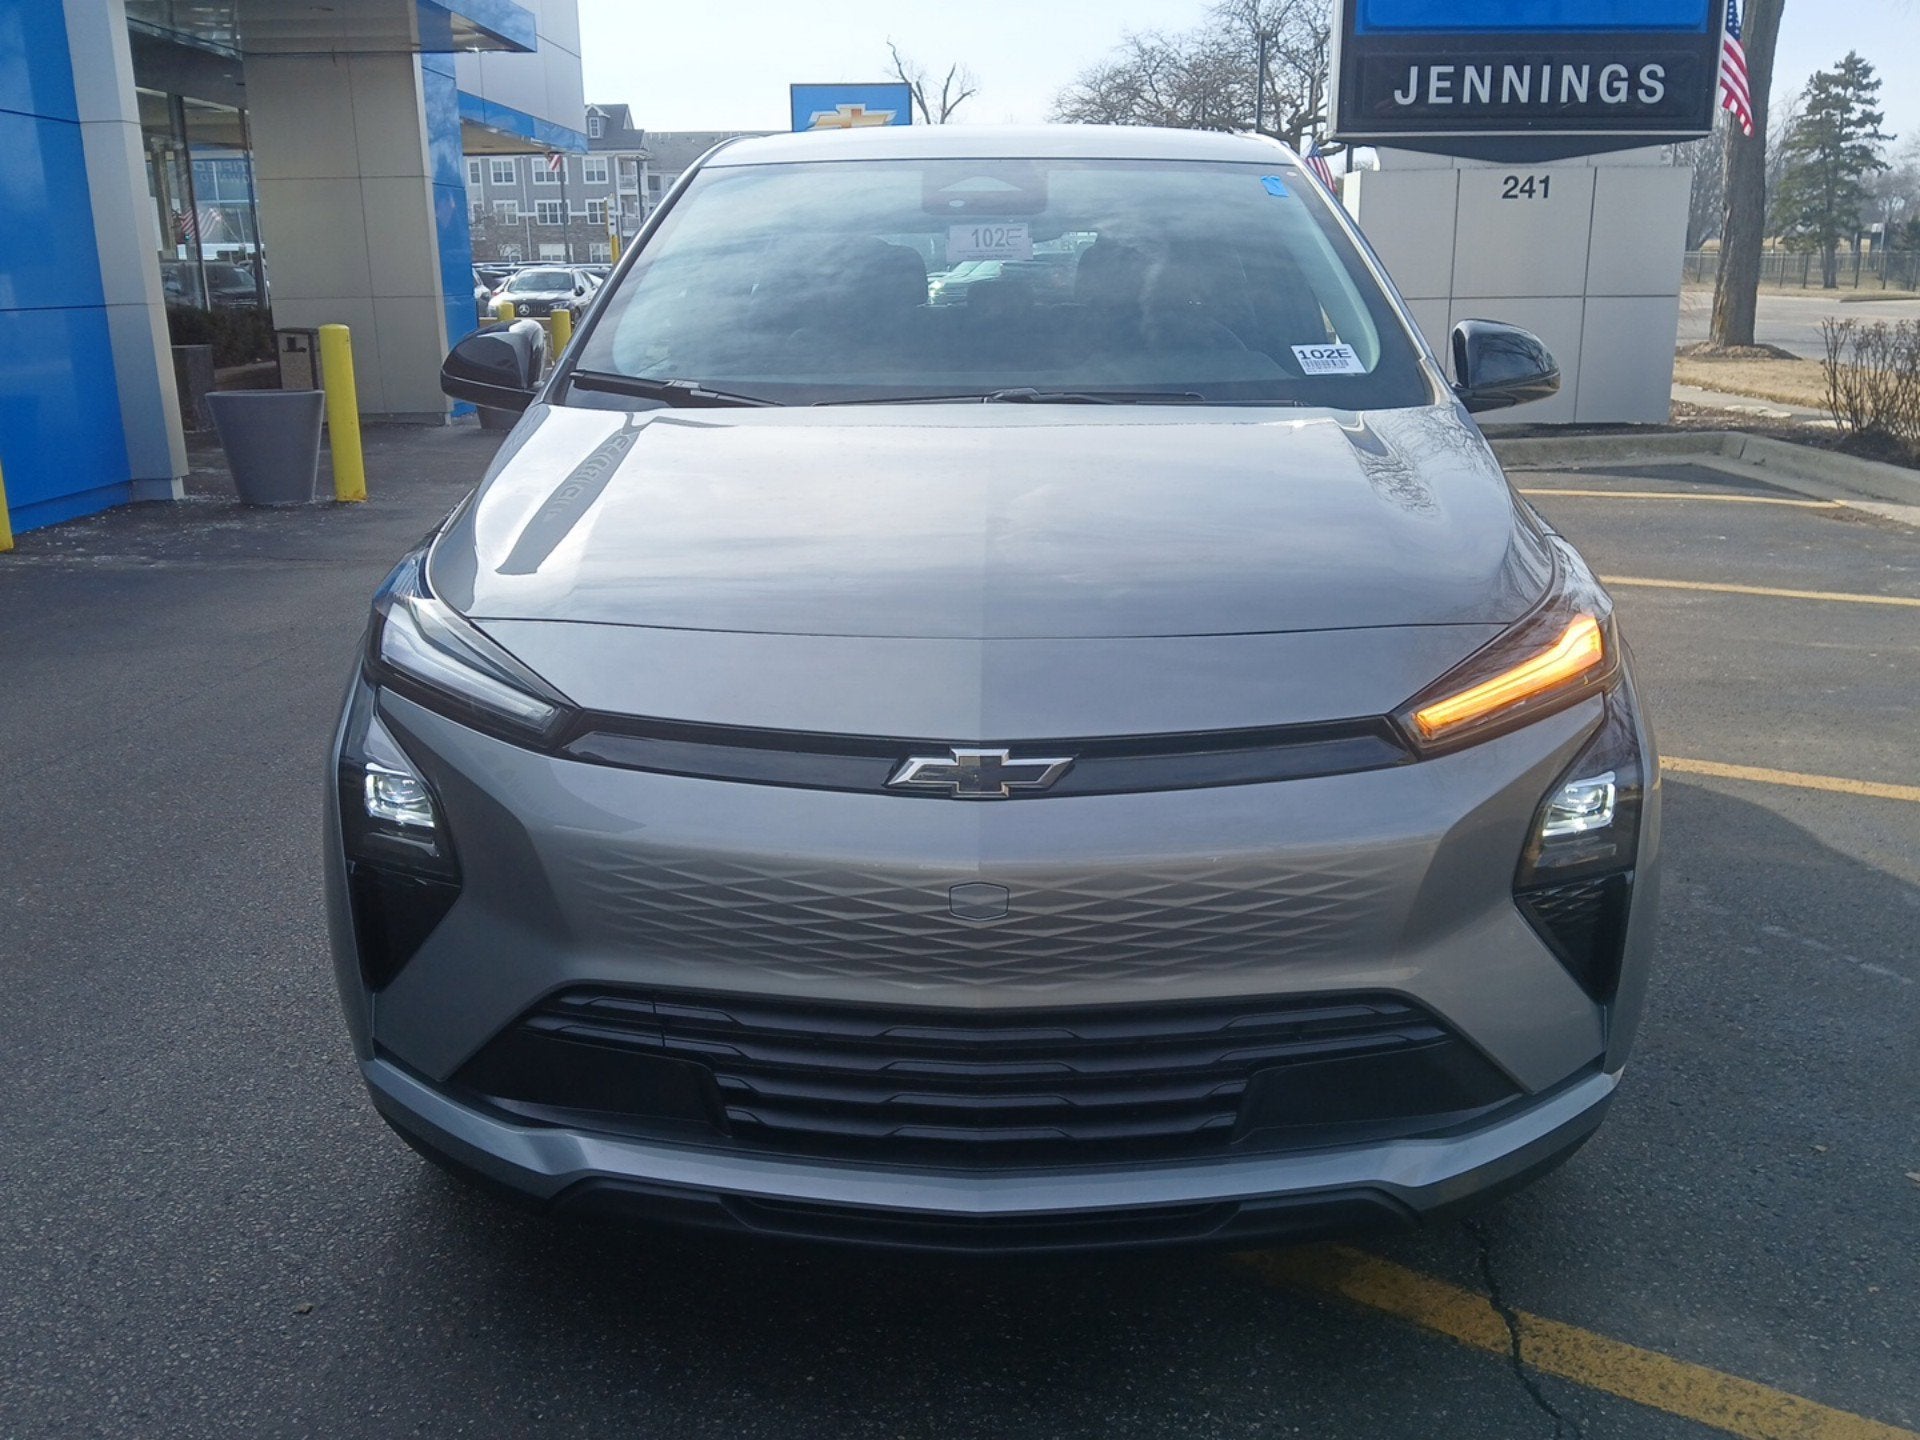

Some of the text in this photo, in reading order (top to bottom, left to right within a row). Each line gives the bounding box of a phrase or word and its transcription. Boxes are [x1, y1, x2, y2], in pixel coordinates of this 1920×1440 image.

[1394, 63, 1666, 106] JENNINGS
[1502, 175, 1550, 199] 241
[971, 228, 1023, 248] 102E
[1298, 348, 1352, 360] 102E
